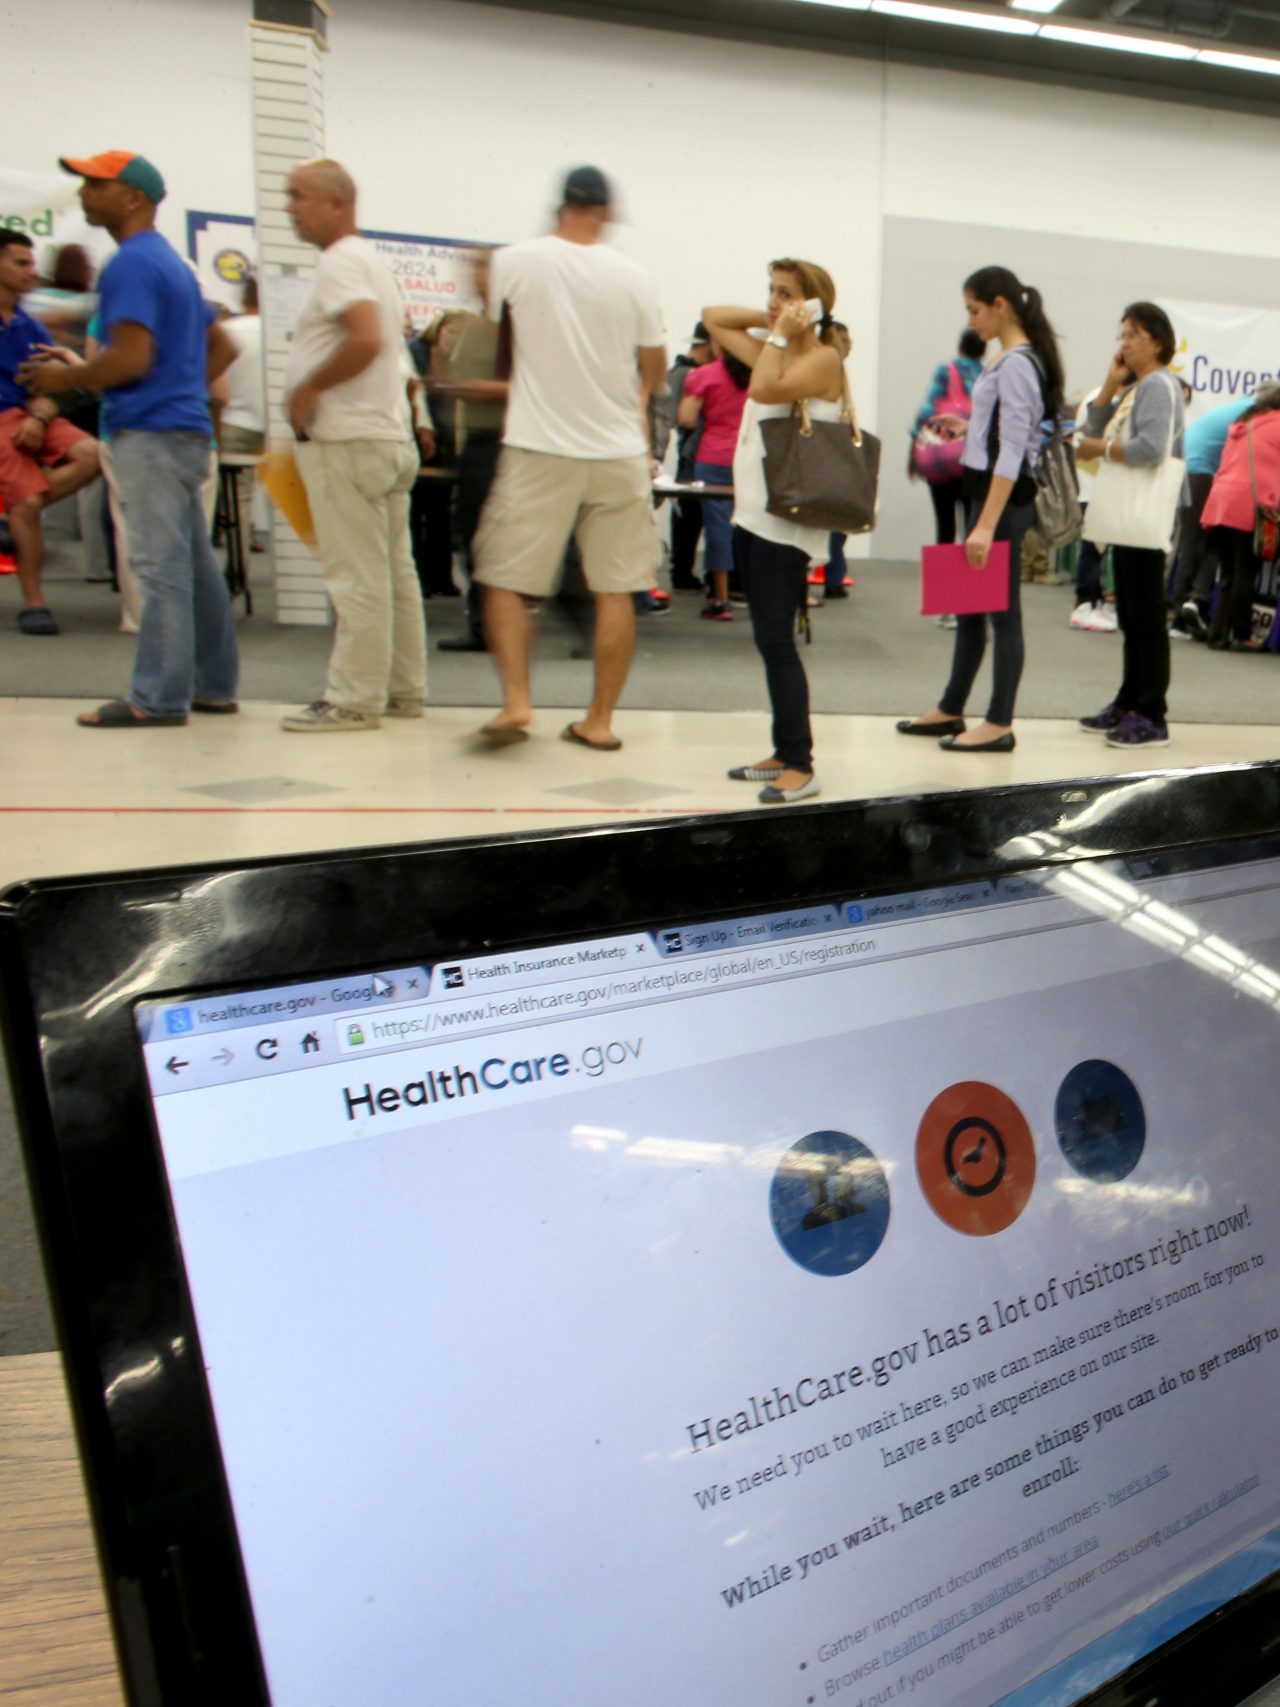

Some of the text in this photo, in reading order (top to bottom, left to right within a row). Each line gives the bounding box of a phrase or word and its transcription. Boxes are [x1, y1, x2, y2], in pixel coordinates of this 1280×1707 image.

[2, 208, 52, 236] ed
[375, 242, 422, 257] Health
[404, 278, 456, 293] SALUD
[685, 932, 709, 948] Sign
[713, 929, 728, 944] Up
[737, 922, 766, 938] Email
[866, 905, 894, 920] yahoo
[898, 901, 916, 914] mail
[924, 896, 954, 910] Google
[373, 938, 876, 1038] https://www.healthcare.gov/marketplace/global/en_US/registration
[467, 963, 511, 980] Health
[514, 955, 575, 973] Insurance
[577, 946, 627, 964] Marketp
[198, 997, 315, 1025] healthcare.gov
[342, 1037, 643, 1120] HealthCare.gov
[686, 1204, 1252, 1454] HealthCare.gov has a lot of visitors right now!
[693, 1253, 1265, 1511] We need you to wait here, so we can make sure there's room for you to
[880, 1331, 1160, 1468] have a good experience on our site.
[720, 1326, 1280, 1609] While you wait, here are some things you can do to get ready to
[1021, 1455, 1081, 1499] enroll:
[817, 1625, 869, 1664] Gather
[872, 1585, 945, 1634] important
[945, 1544, 1019, 1594] documents
[1022, 1528, 1045, 1553] and
[1047, 1500, 1102, 1537] numbers
[824, 1536, 1098, 1697] Browse health plans available in your area
[867, 1684, 895, 1707] out
[896, 1675, 907, 1694] if
[908, 1664, 935, 1692] you
[937, 1638, 976, 1670] might
[976, 1627, 996, 1646] be
[997, 1609, 1025, 1635] able
[1027, 1600, 1042, 1617] to
[1042, 1584, 1064, 1613] get
[1065, 1568, 1097, 1595] lower
[1099, 1551, 1130, 1575] costs
[1131, 1530, 1162, 1557] using
